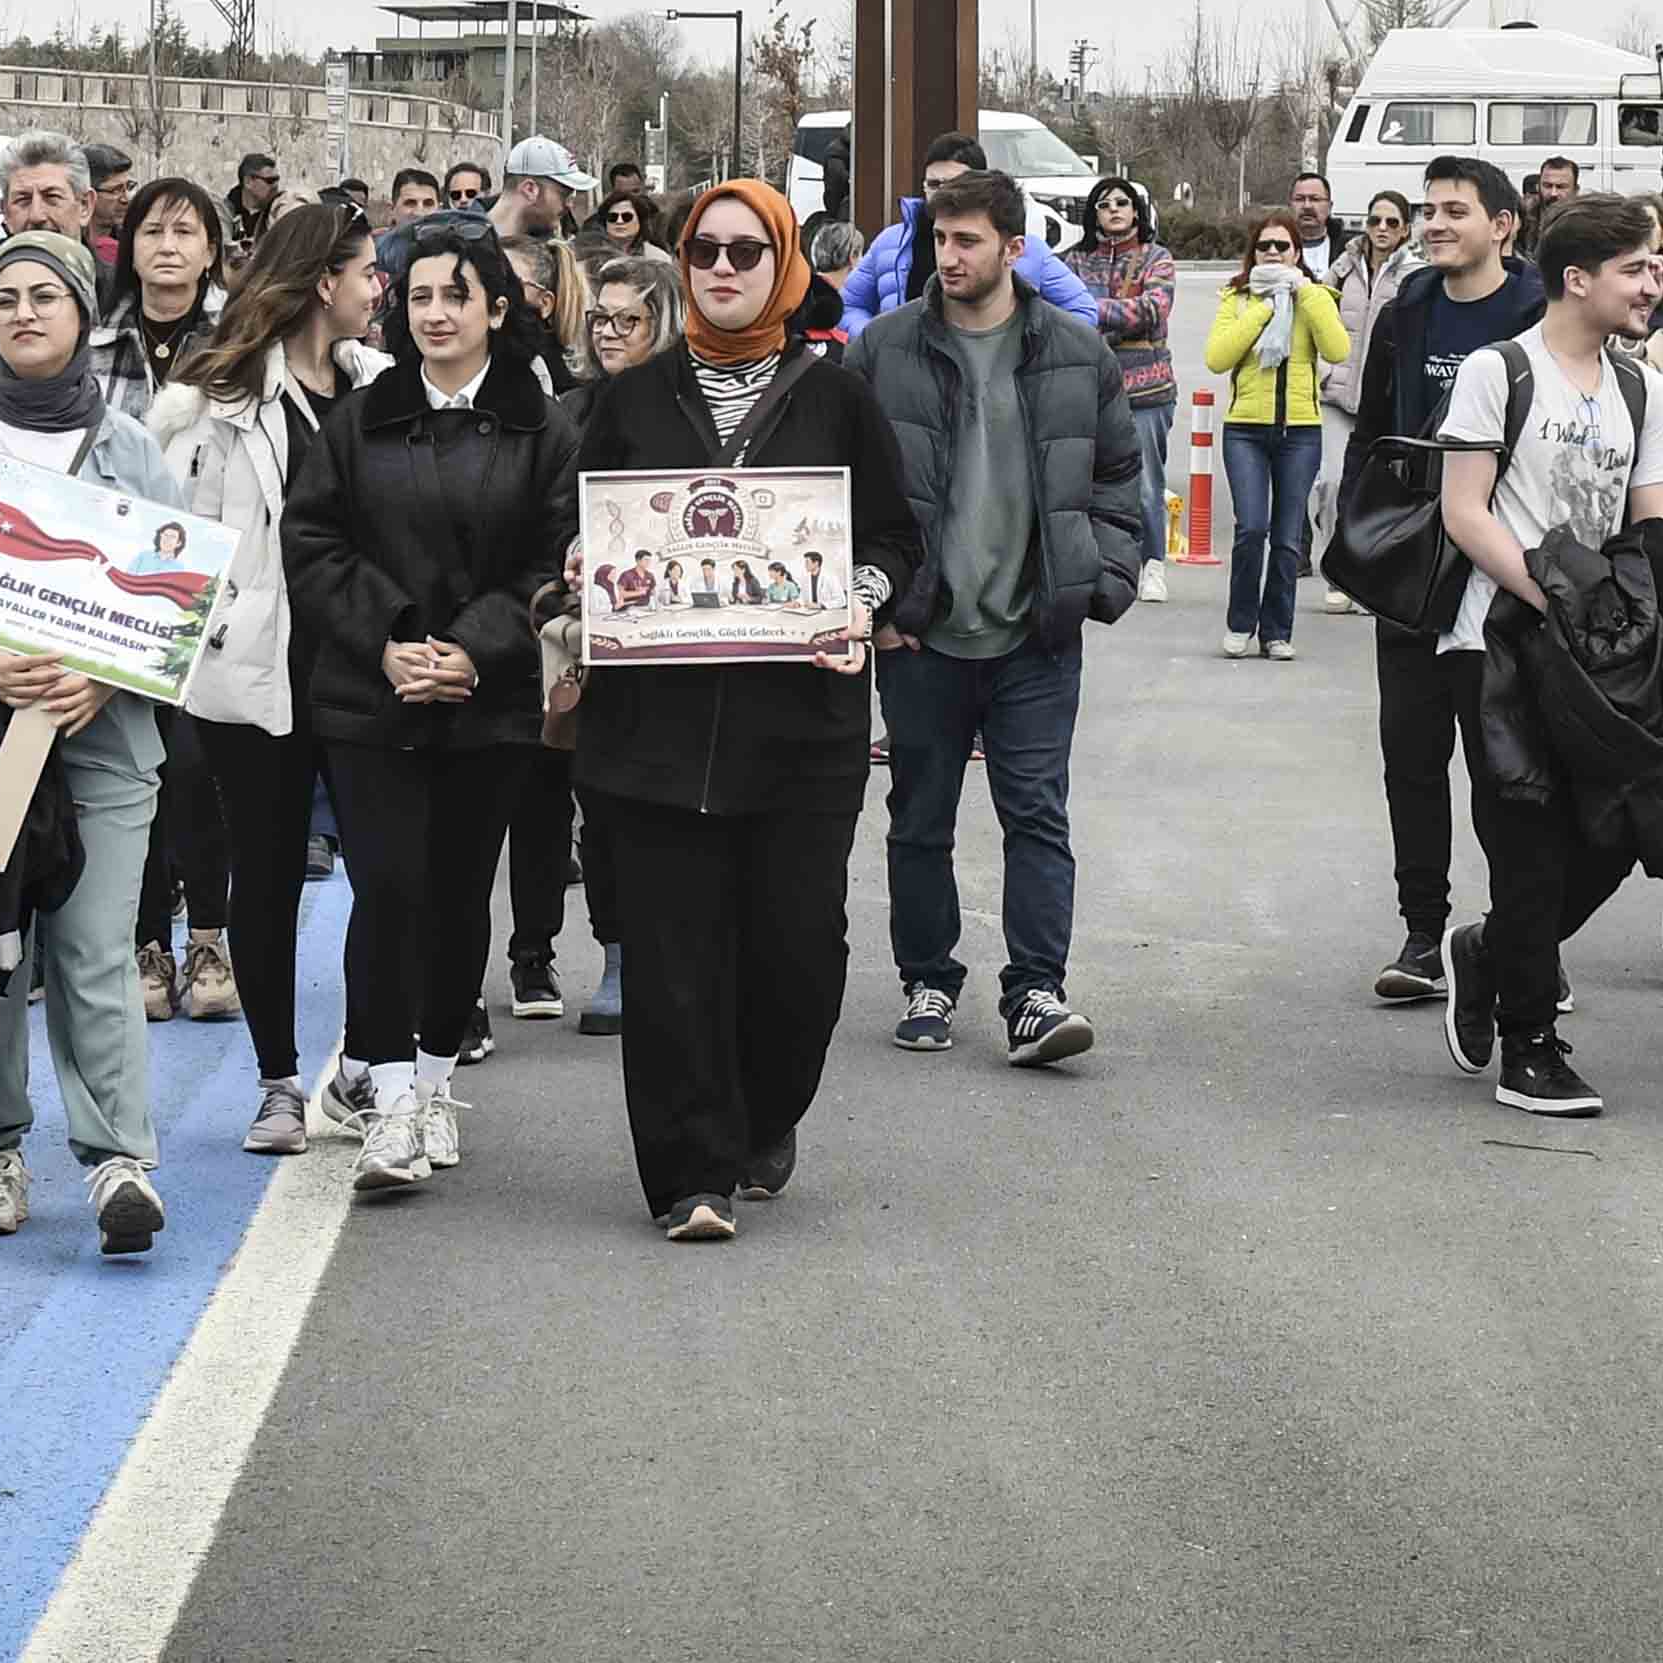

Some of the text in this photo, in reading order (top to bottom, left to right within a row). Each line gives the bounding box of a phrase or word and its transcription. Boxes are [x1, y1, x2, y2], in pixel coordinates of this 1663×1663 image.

[1424, 363, 1461, 377] WAV
[38, 587, 107, 620] GENÇLİK
[109, 610, 177, 642] MECLİSİ
[49, 615, 86, 633] YARIM
